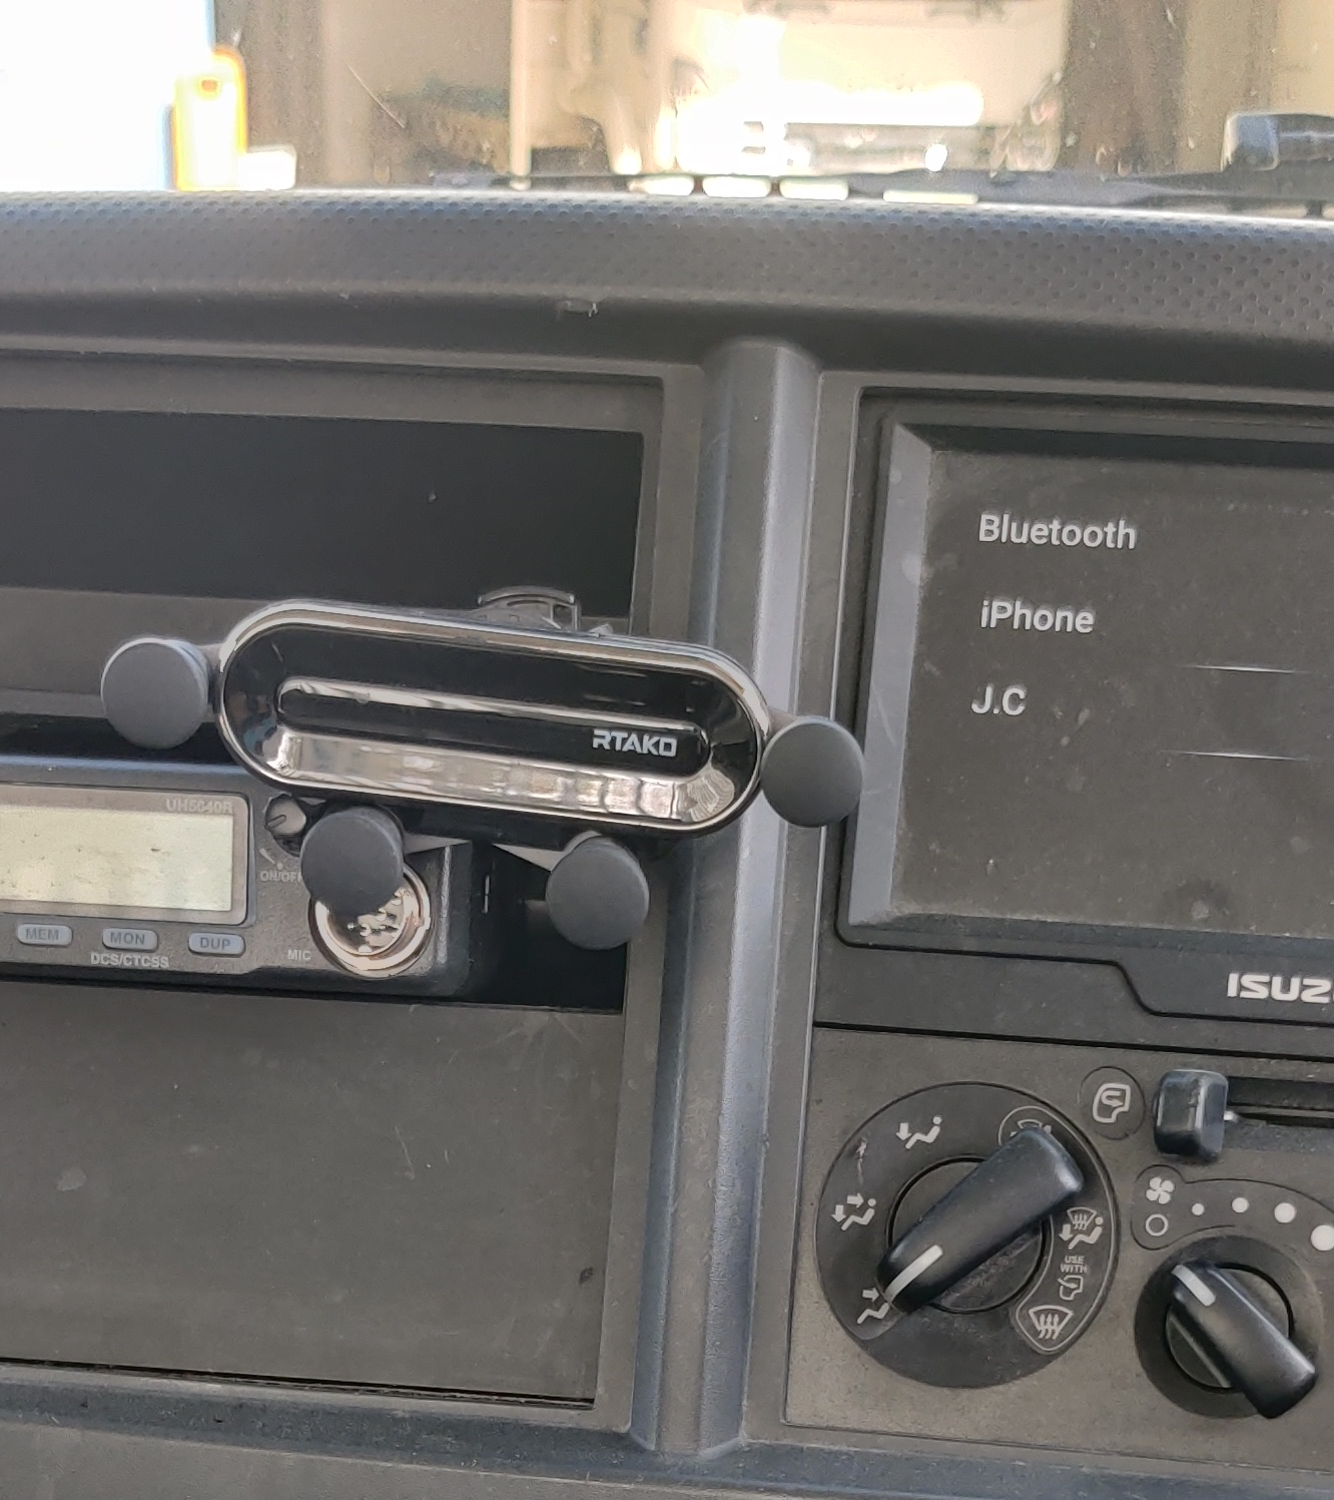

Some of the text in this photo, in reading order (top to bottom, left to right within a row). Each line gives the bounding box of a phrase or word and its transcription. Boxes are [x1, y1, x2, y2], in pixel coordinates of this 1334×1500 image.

[978, 511, 1137, 550] Bluetooth
[980, 598, 1095, 633] iPhone
[970, 682, 1027, 716] J.C
[593, 728, 678, 757] RTAKO
[25, 928, 60, 942] MEM
[110, 932, 146, 946] MON
[200, 936, 231, 950] DUP
[90, 952, 169, 968] DCS/CTCSS
[287, 949, 312, 961] MIC
[1064, 1255, 1085, 1264] USE
[1060, 1264, 1087, 1274] WITH
